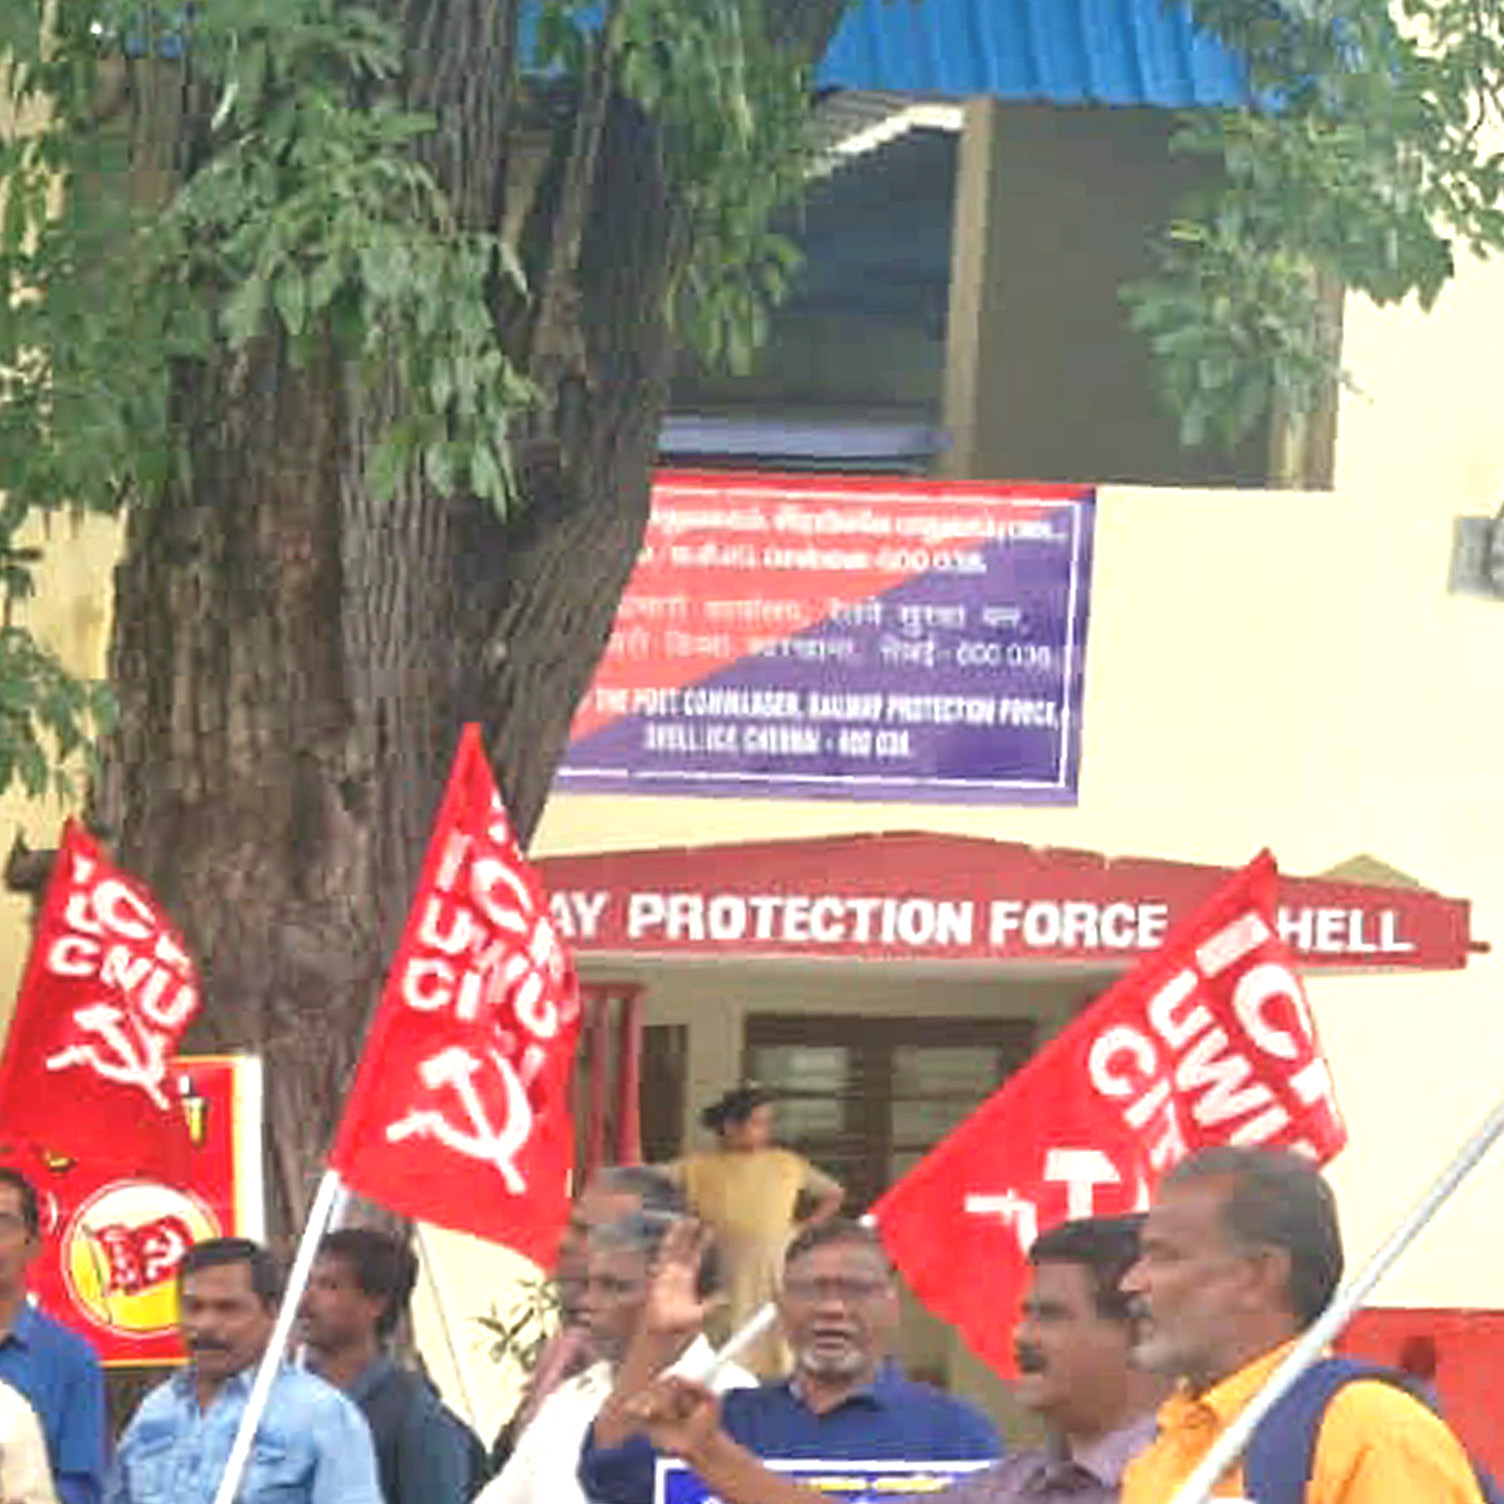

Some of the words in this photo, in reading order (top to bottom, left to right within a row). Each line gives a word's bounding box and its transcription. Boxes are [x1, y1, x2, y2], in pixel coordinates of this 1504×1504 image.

[627, 892, 973, 945] PROTECTION
[991, 897, 1169, 950] FORCE
[1276, 904, 1415, 953] HELL
